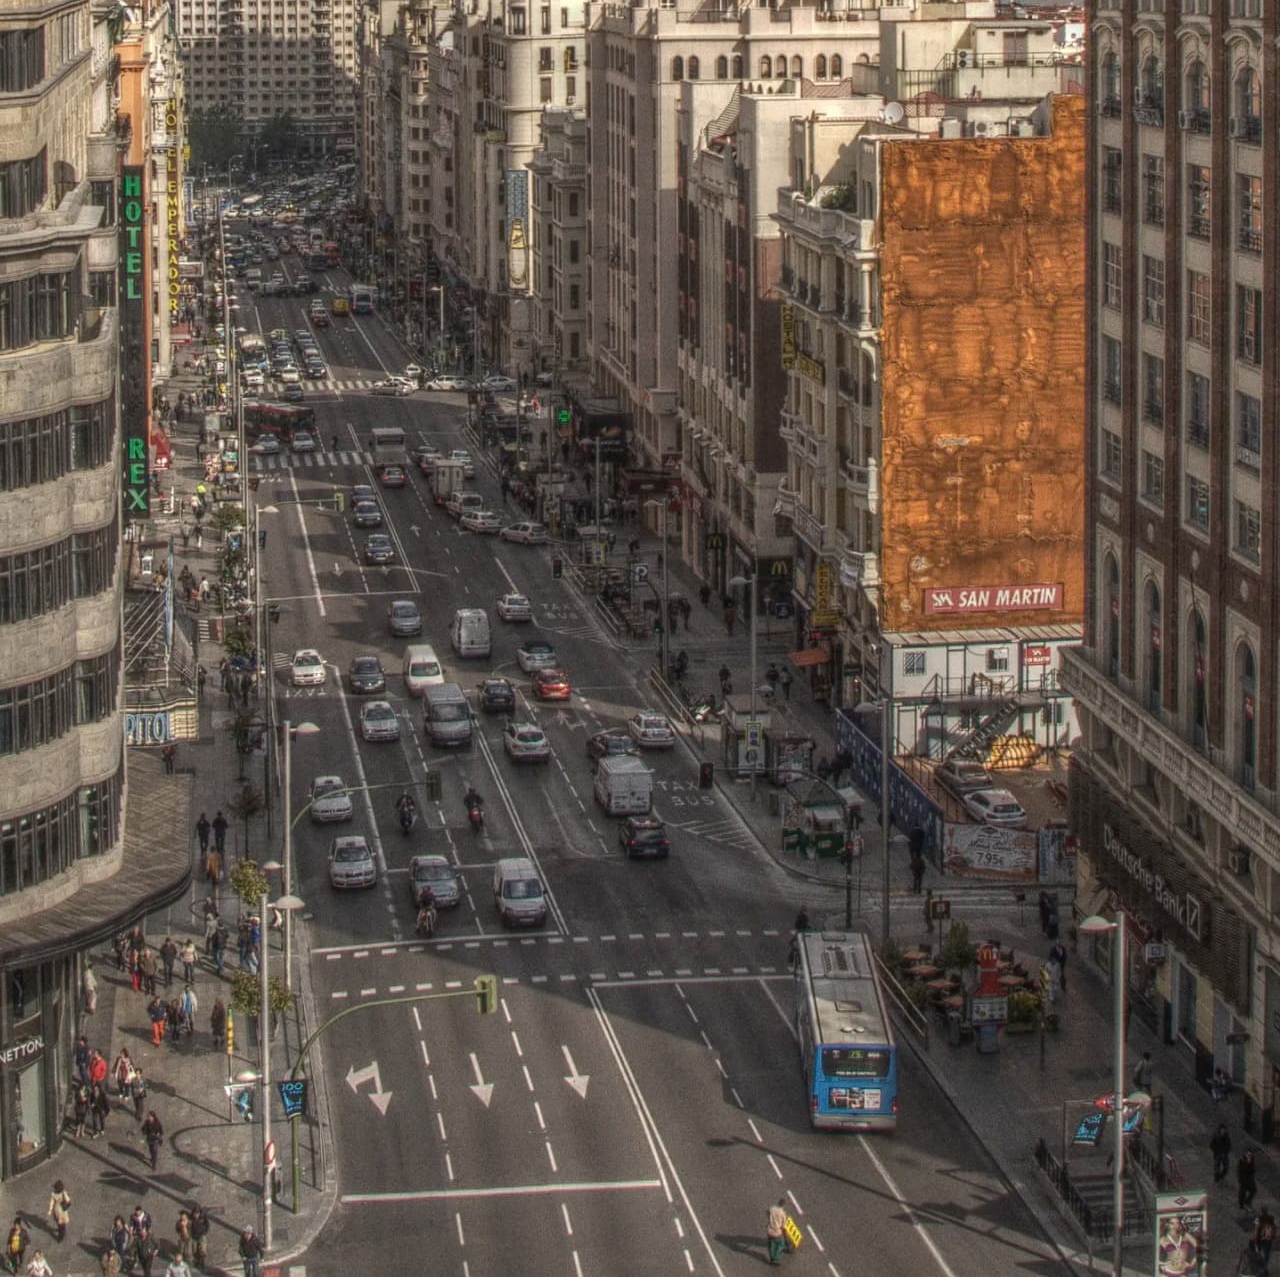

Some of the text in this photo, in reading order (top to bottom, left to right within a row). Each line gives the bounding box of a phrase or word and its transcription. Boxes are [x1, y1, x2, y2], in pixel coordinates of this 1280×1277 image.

[167, 181, 179, 311] EMPERADOR
[125, 176, 148, 510] HOTEL REX
[958, 590, 990, 608] SAN
[995, 587, 1057, 607] MARTIN
[1103, 822, 1153, 893] Deutsche
[1154, 874, 1184, 925] Bank
[282, 1082, 304, 1091] 100
